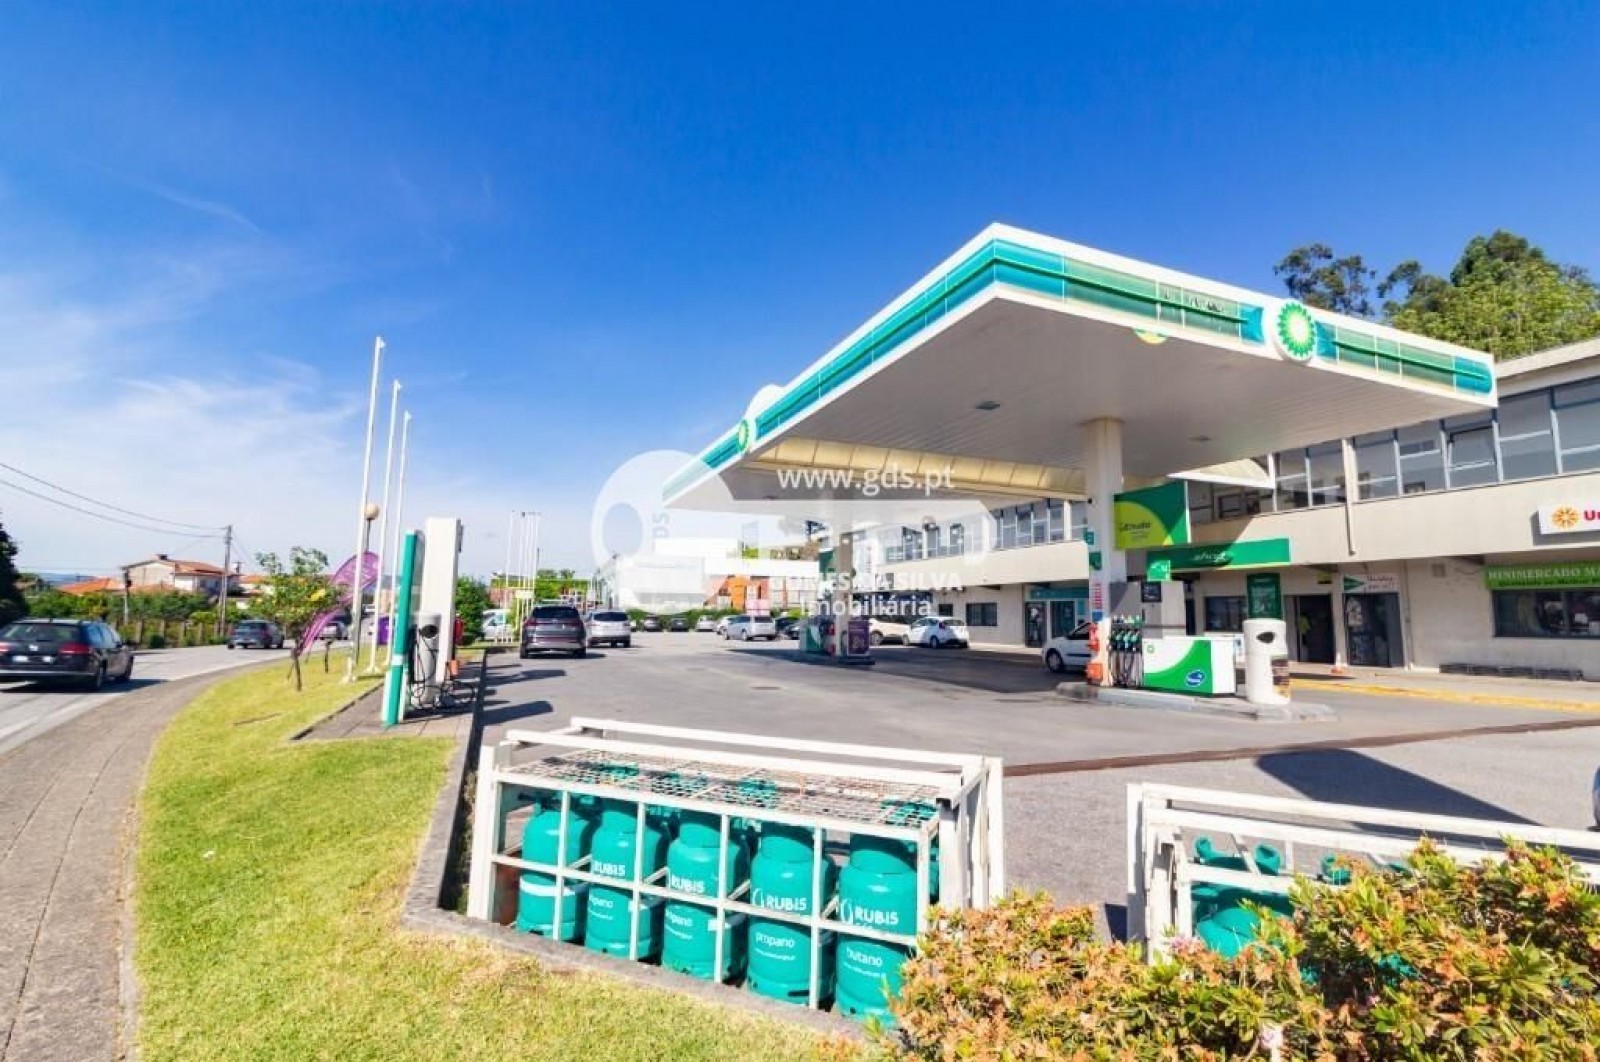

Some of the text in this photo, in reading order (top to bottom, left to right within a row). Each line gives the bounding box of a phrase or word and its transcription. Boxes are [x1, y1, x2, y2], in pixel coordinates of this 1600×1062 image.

[1488, 567, 1581, 579] MINIMERCADO
[671, 874, 705, 894] RUBIS
[765, 894, 807, 912] RUBIS
[854, 906, 899, 926] RUBIS
[754, 931, 796, 949] propano
